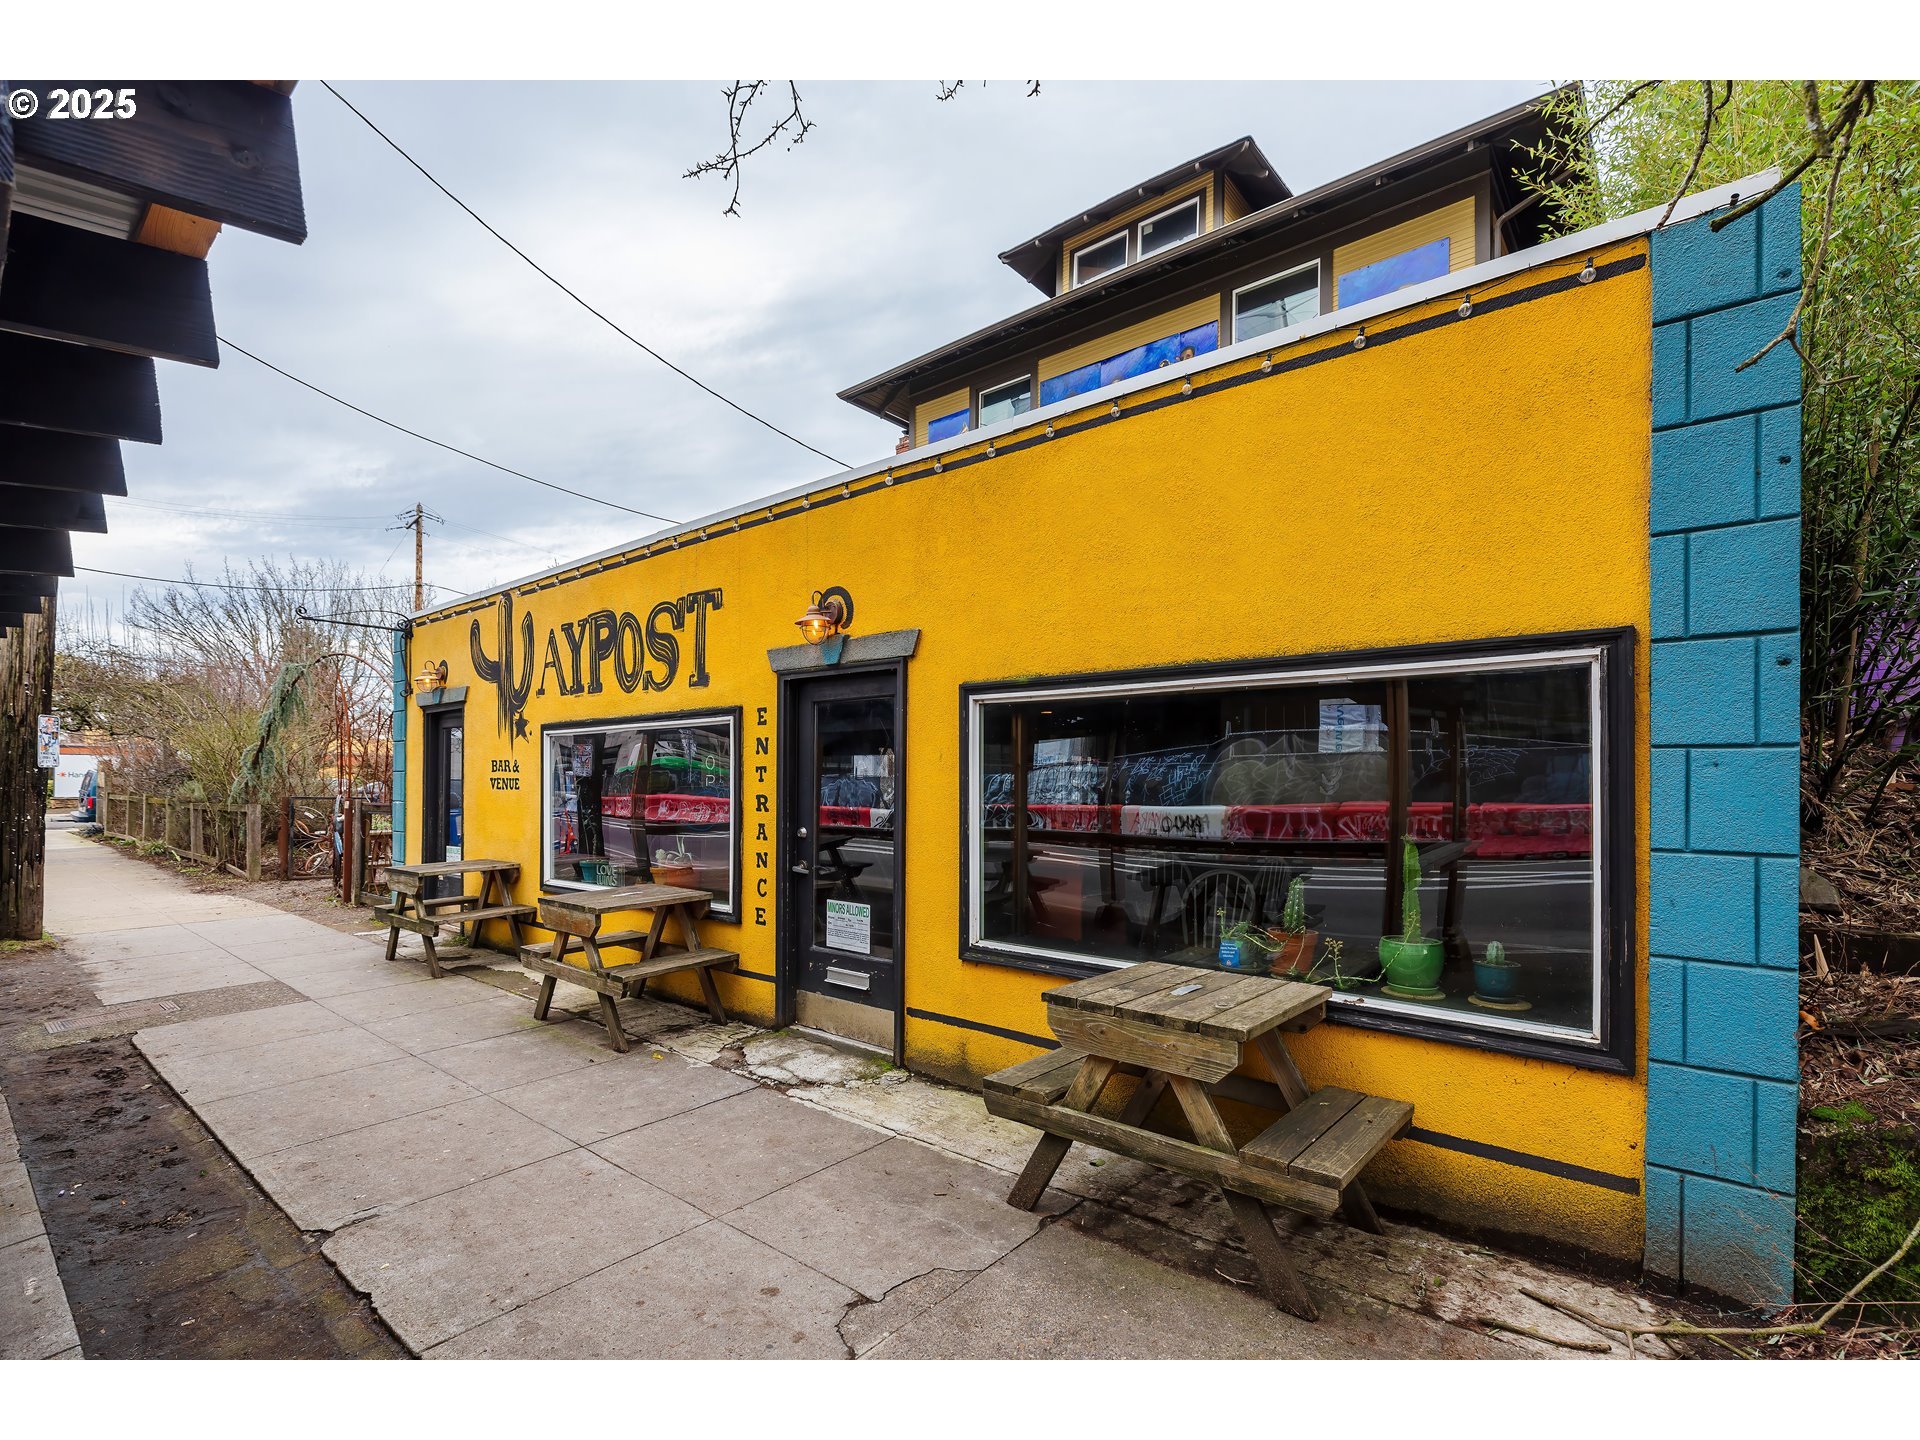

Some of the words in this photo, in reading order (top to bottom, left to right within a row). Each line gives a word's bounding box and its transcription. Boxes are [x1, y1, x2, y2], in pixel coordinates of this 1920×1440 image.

[470, 588, 724, 738] WAYPOST
[491, 759, 511, 773] BAR
[512, 759, 520, 773] &
[489, 777, 520, 791] VENUE
[755, 707, 771, 926] ENTRANCE
[596, 864, 618, 875] LOVE
[596, 874, 618, 887] WINS
[828, 902, 846, 915] MINORS
[846, 905, 869, 919] ALLOWED
